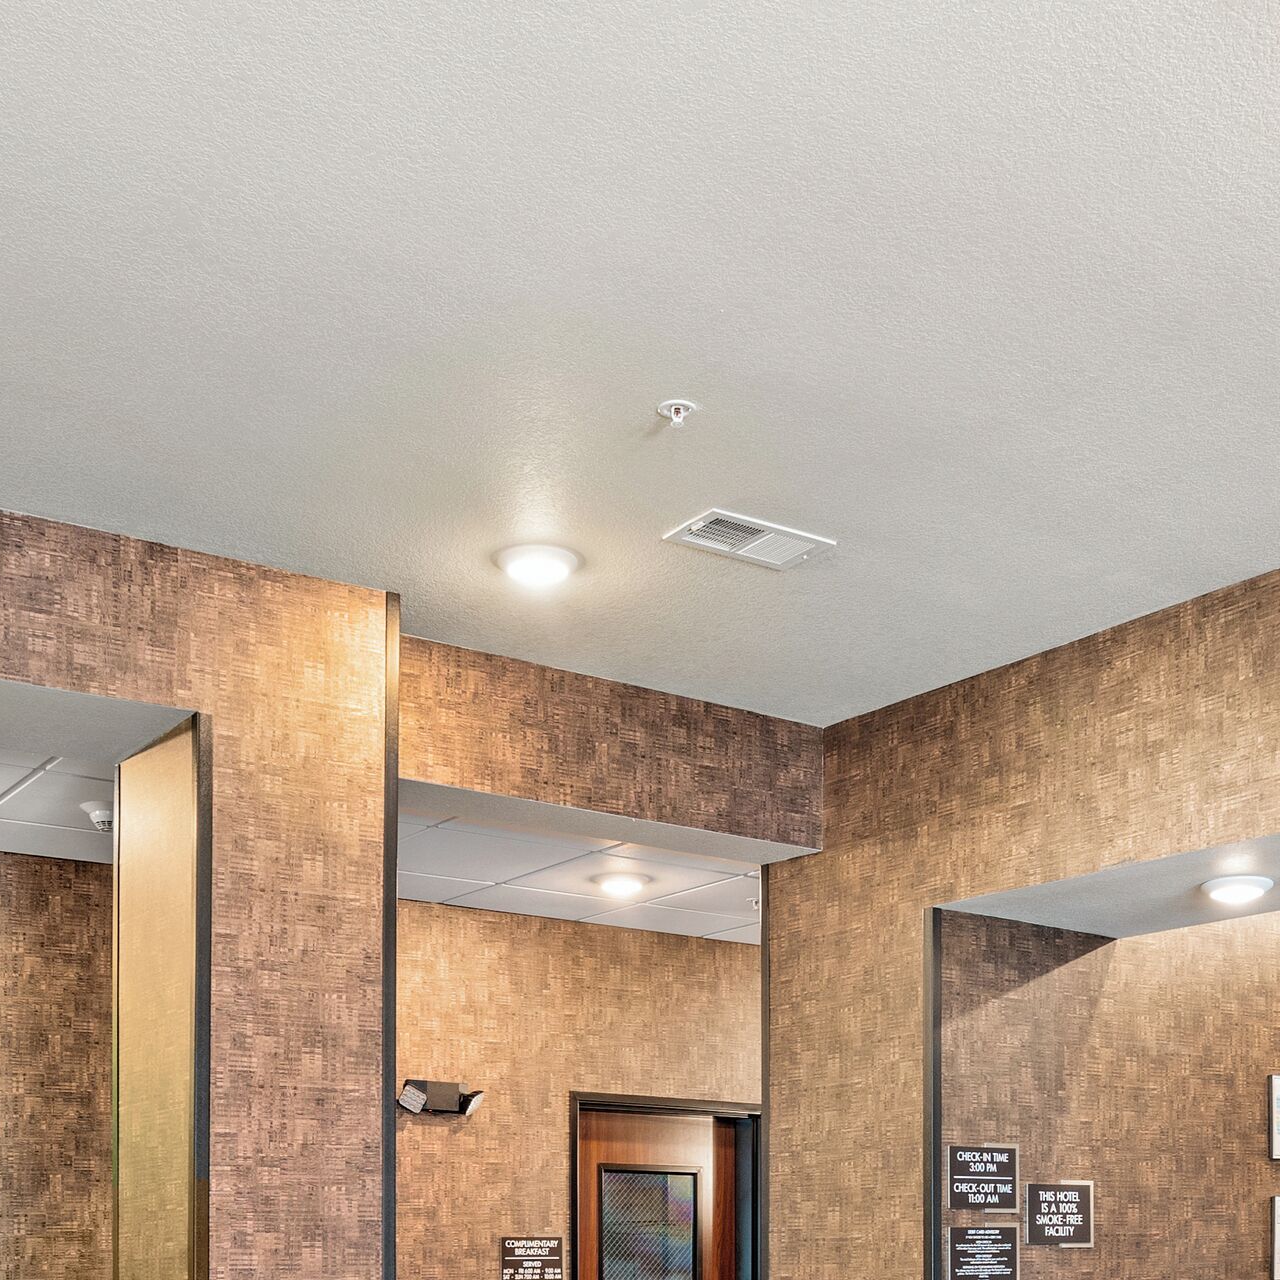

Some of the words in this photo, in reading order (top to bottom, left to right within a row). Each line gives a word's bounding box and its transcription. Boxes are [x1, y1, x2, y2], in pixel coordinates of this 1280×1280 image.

[956, 1151, 991, 1163] CHECK-IN
[993, 1152, 1009, 1163] TIME
[969, 1162, 985, 1172] 3:00
[986, 1163, 997, 1173] PM
[953, 1182, 995, 1194] CHECK-OUT
[996, 1183, 1013, 1194] TIME
[968, 1193, 985, 1203] 11:00
[986, 1194, 1000, 1204] AM
[1039, 1191, 1055, 1202] THIS
[1056, 1191, 1080, 1202] HOTEL
[1041, 1203, 1049, 1213] IS
[1050, 1203, 1058, 1213] A
[1059, 1203, 1078, 1214] 100%
[1036, 1214, 1083, 1225] SMOKE-FREE
[1044, 1226, 1075, 1237] FACILITY
[505, 1240, 558, 1248] COMPLIMENTARY
